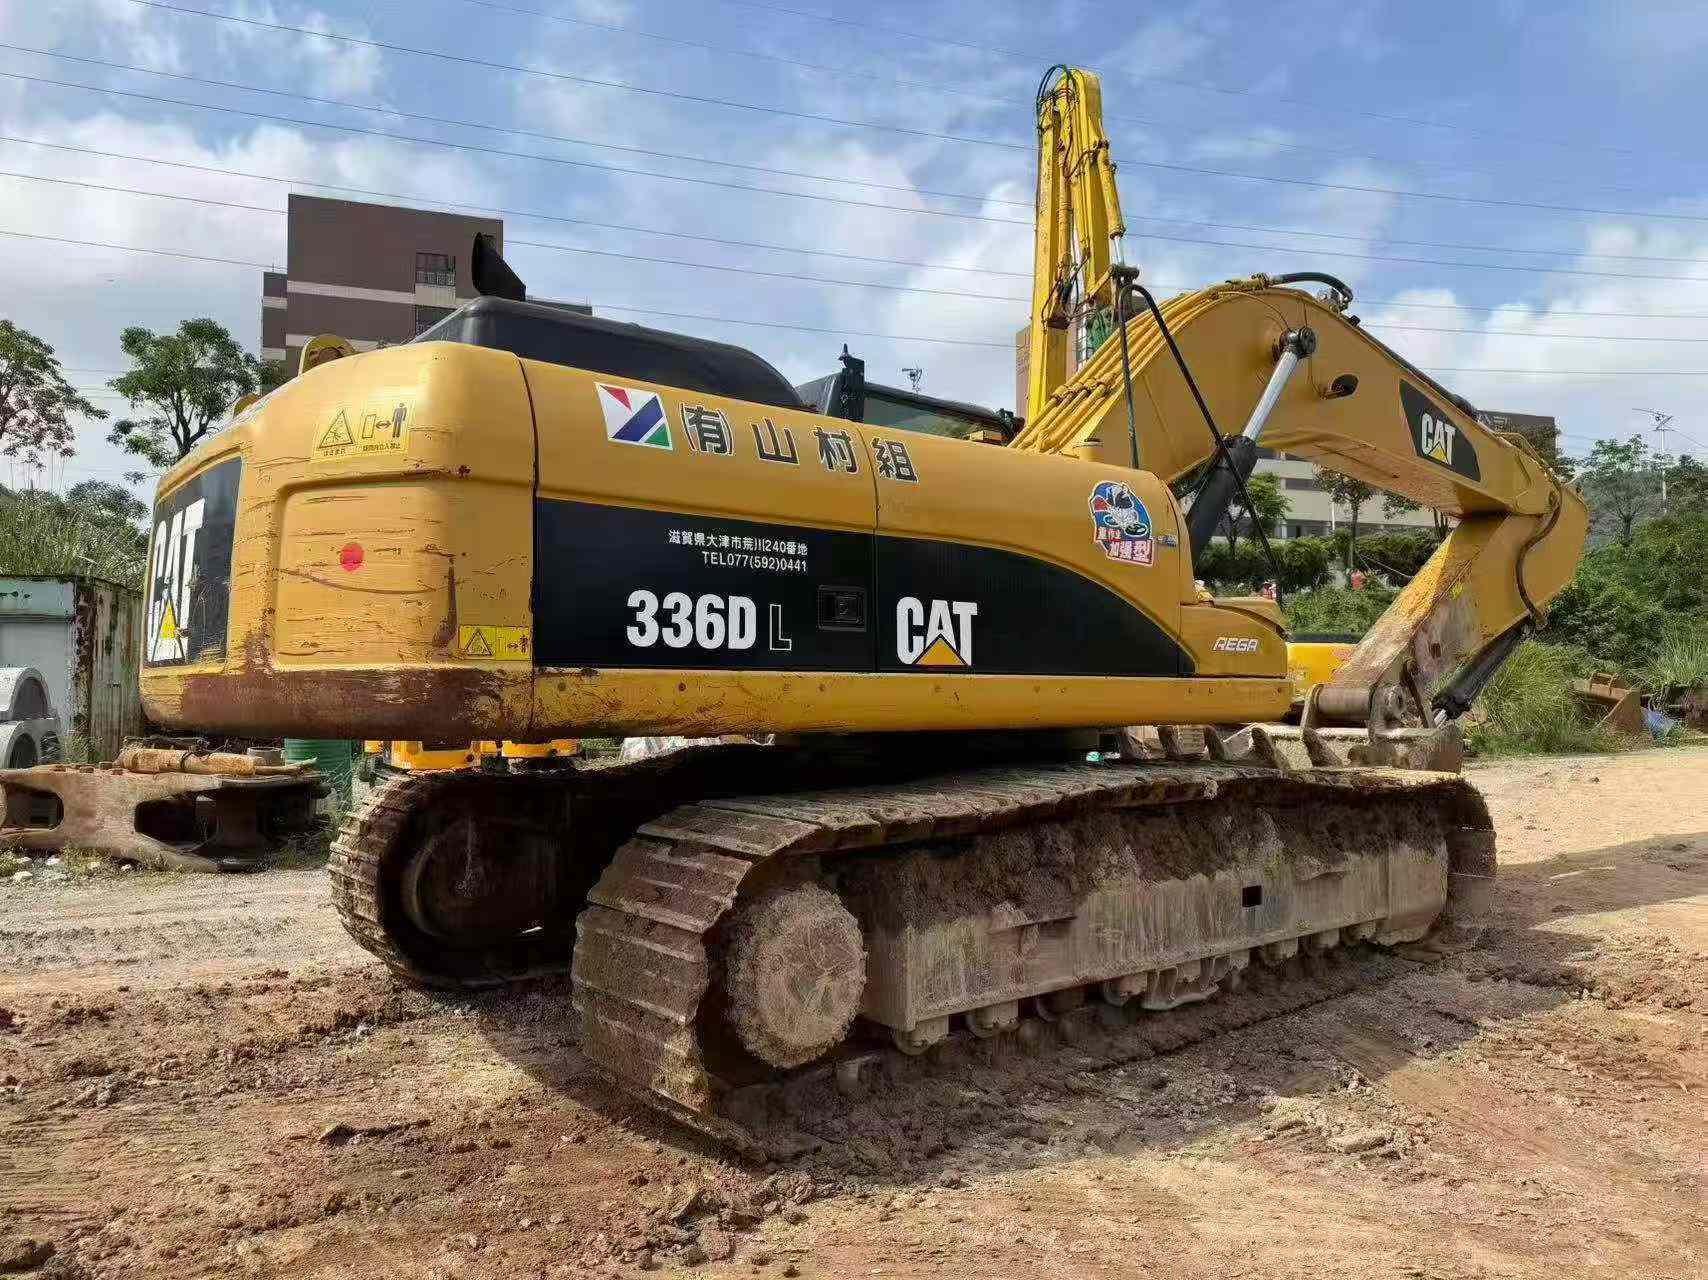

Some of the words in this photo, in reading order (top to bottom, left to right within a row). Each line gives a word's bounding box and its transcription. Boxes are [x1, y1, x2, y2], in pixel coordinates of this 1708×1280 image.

[1421, 412, 1456, 466] CAT
[147, 498, 205, 662] CAT
[702, 551, 807, 572] TEL077(592)0441
[626, 589, 757, 650] 336D
[769, 603, 792, 651] L
[896, 596, 978, 666] CAT
